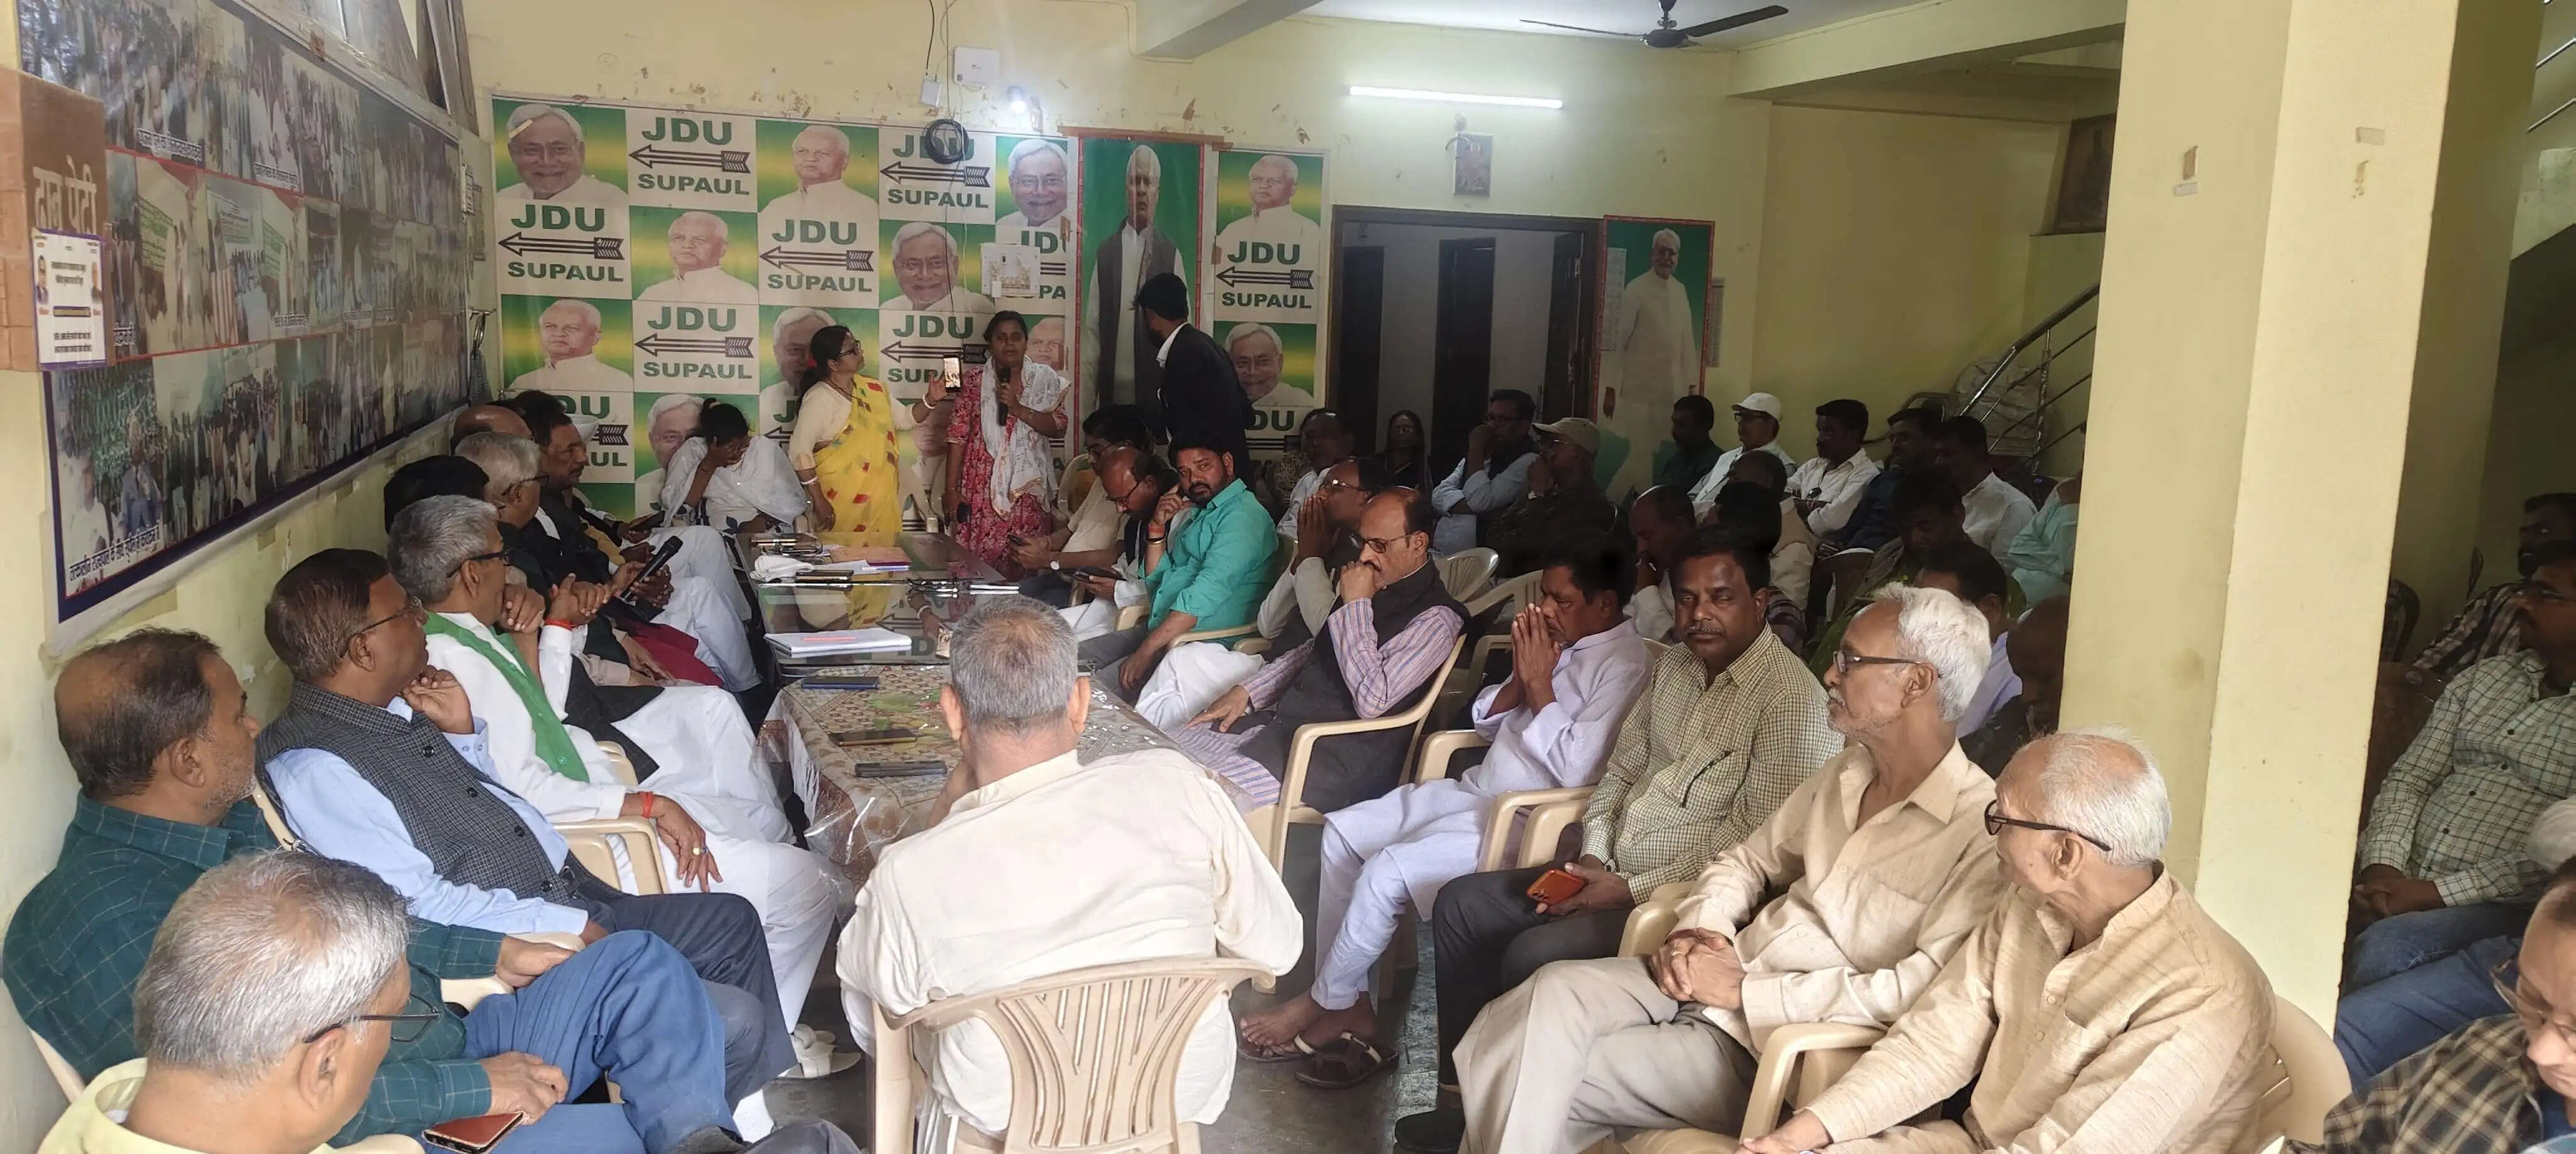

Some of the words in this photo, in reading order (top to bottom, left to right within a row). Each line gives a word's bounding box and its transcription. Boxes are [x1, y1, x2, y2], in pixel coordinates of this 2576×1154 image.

[642, 117, 732, 145] JDU
[33, 166, 62, 231] दान
[65, 154, 97, 235] पेटी
[638, 174, 750, 196] SUPAUL
[888, 189, 989, 208] SUPAUL
[511, 204, 605, 232] JDU
[772, 219, 857, 245] JDU
[1228, 241, 1300, 265] JDU
[508, 262, 623, 282] SUPAUL
[768, 274, 872, 292] SUPAUL
[1222, 292, 1311, 309] SUPAUL
[647, 306, 736, 331] JDU
[893, 315, 973, 338] JDU
[642, 362, 753, 379] SUPAUL
[887, 368, 945, 383] SUP
[1250, 409, 1294, 431] DU
